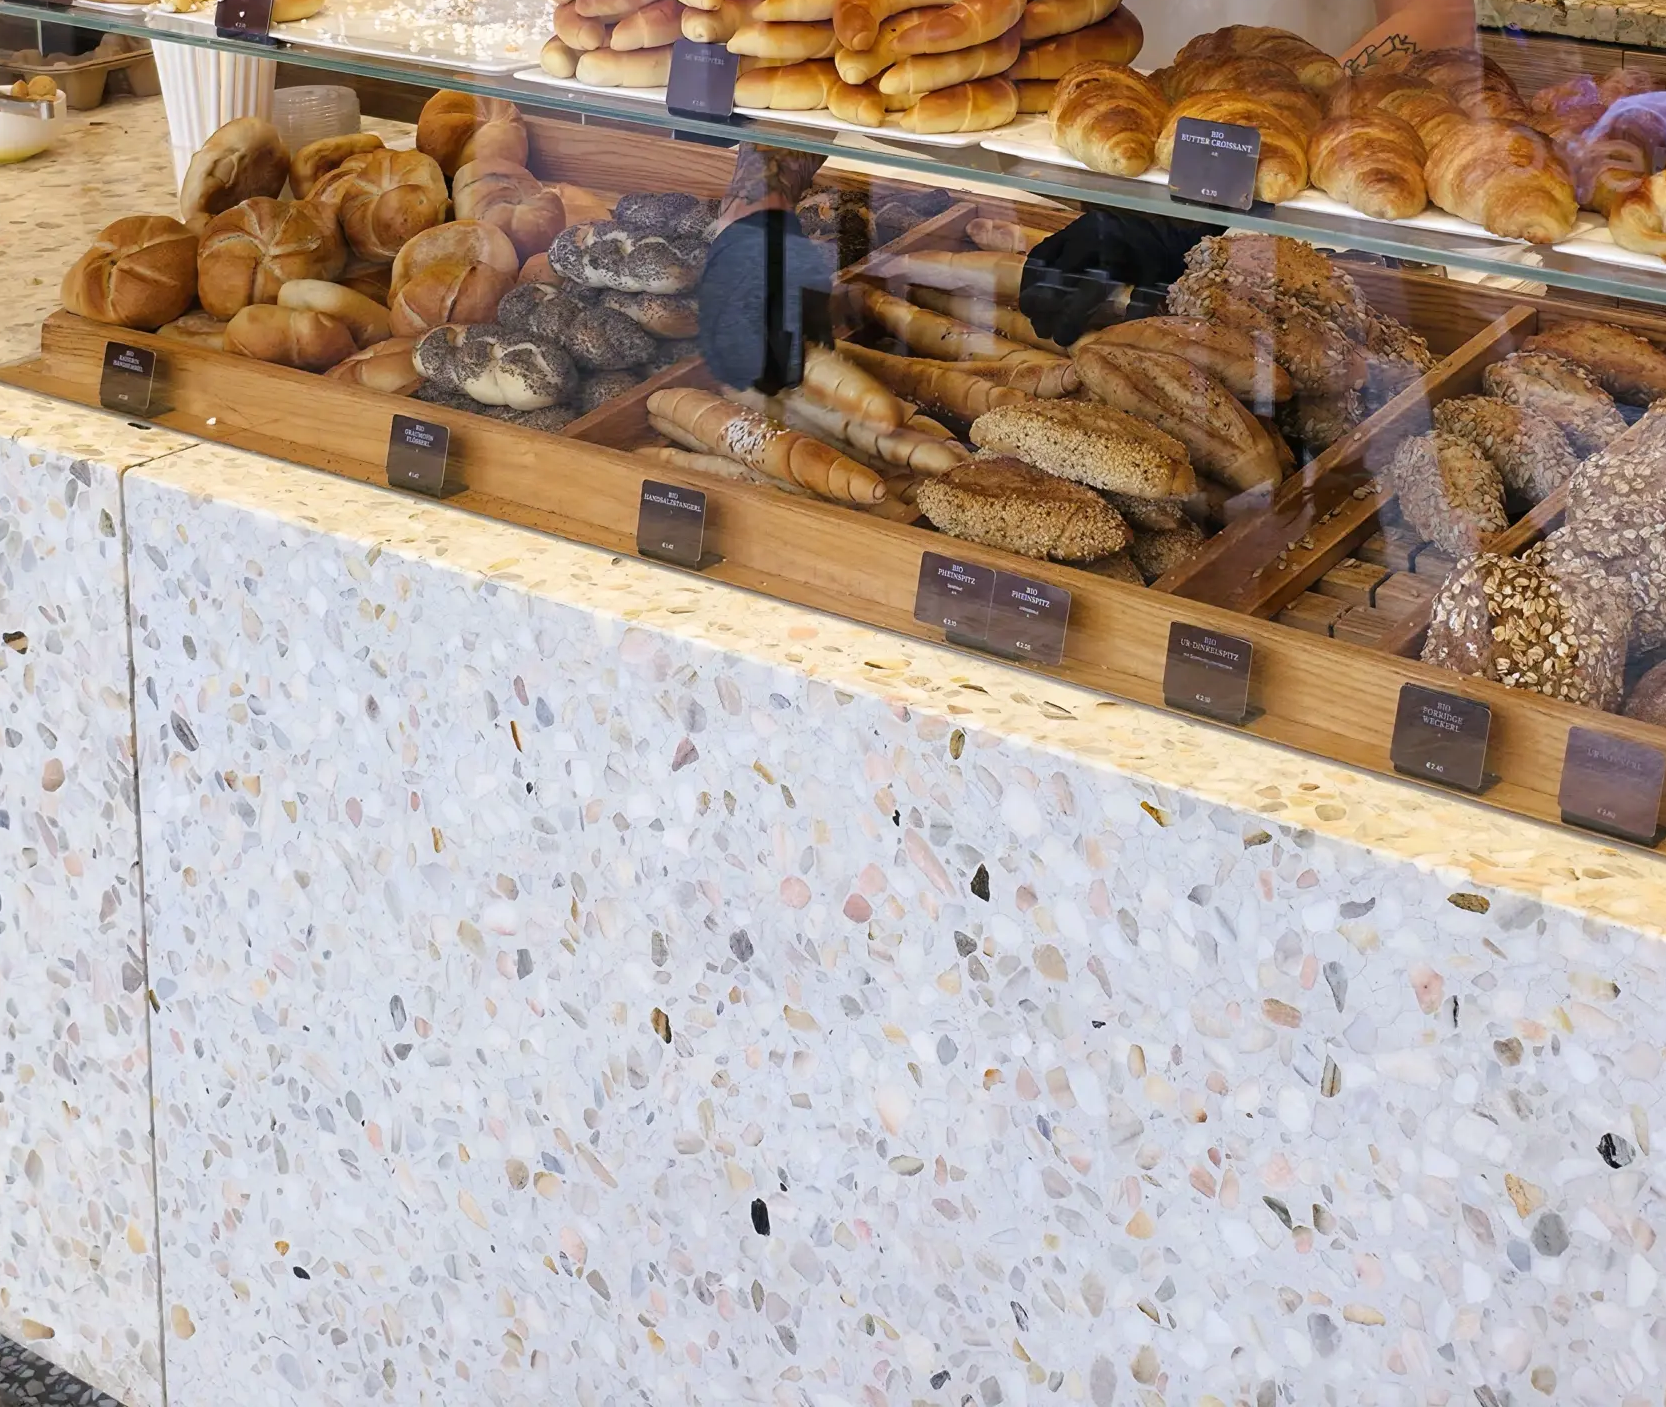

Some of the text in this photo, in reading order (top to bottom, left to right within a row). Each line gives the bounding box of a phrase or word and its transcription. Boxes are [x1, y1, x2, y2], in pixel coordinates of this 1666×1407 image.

[1211, 130, 1225, 139] BIO
[1181, 133, 1253, 154] BUTTER CROISSANT
[668, 491, 679, 500] BIO
[952, 563, 964, 573] BIO
[937, 568, 977, 585] PHEINSPITZ
[1025, 586, 1038, 596] BIO
[1011, 590, 1051, 608] PHEINSPITZ
[1204, 636, 1217, 646] BIO
[1180, 637, 1240, 662] UR-DINKELSPITZ
[1437, 701, 1451, 713] BIO
[1421, 706, 1464, 725] PORRIDGE
[1422, 715, 1461, 733] WECKERL
